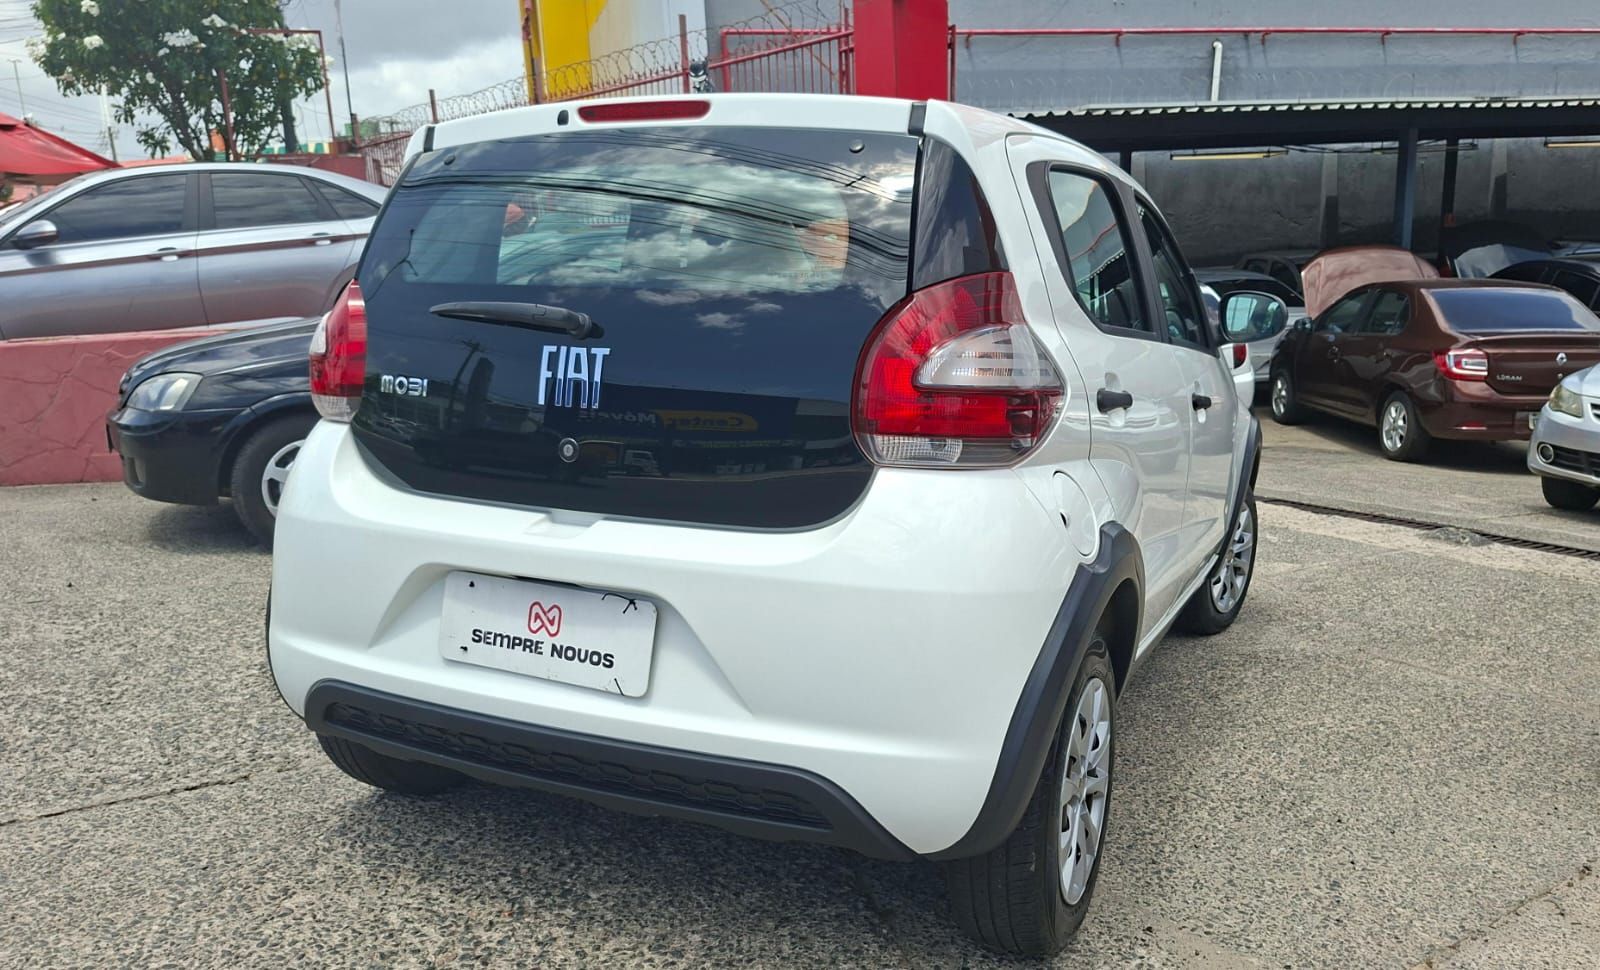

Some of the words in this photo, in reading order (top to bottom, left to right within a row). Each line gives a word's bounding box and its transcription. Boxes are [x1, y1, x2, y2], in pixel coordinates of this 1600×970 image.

[380, 374, 429, 398] MOBI
[538, 345, 611, 409] FIAT
[471, 628, 544, 656] SEMPRE
